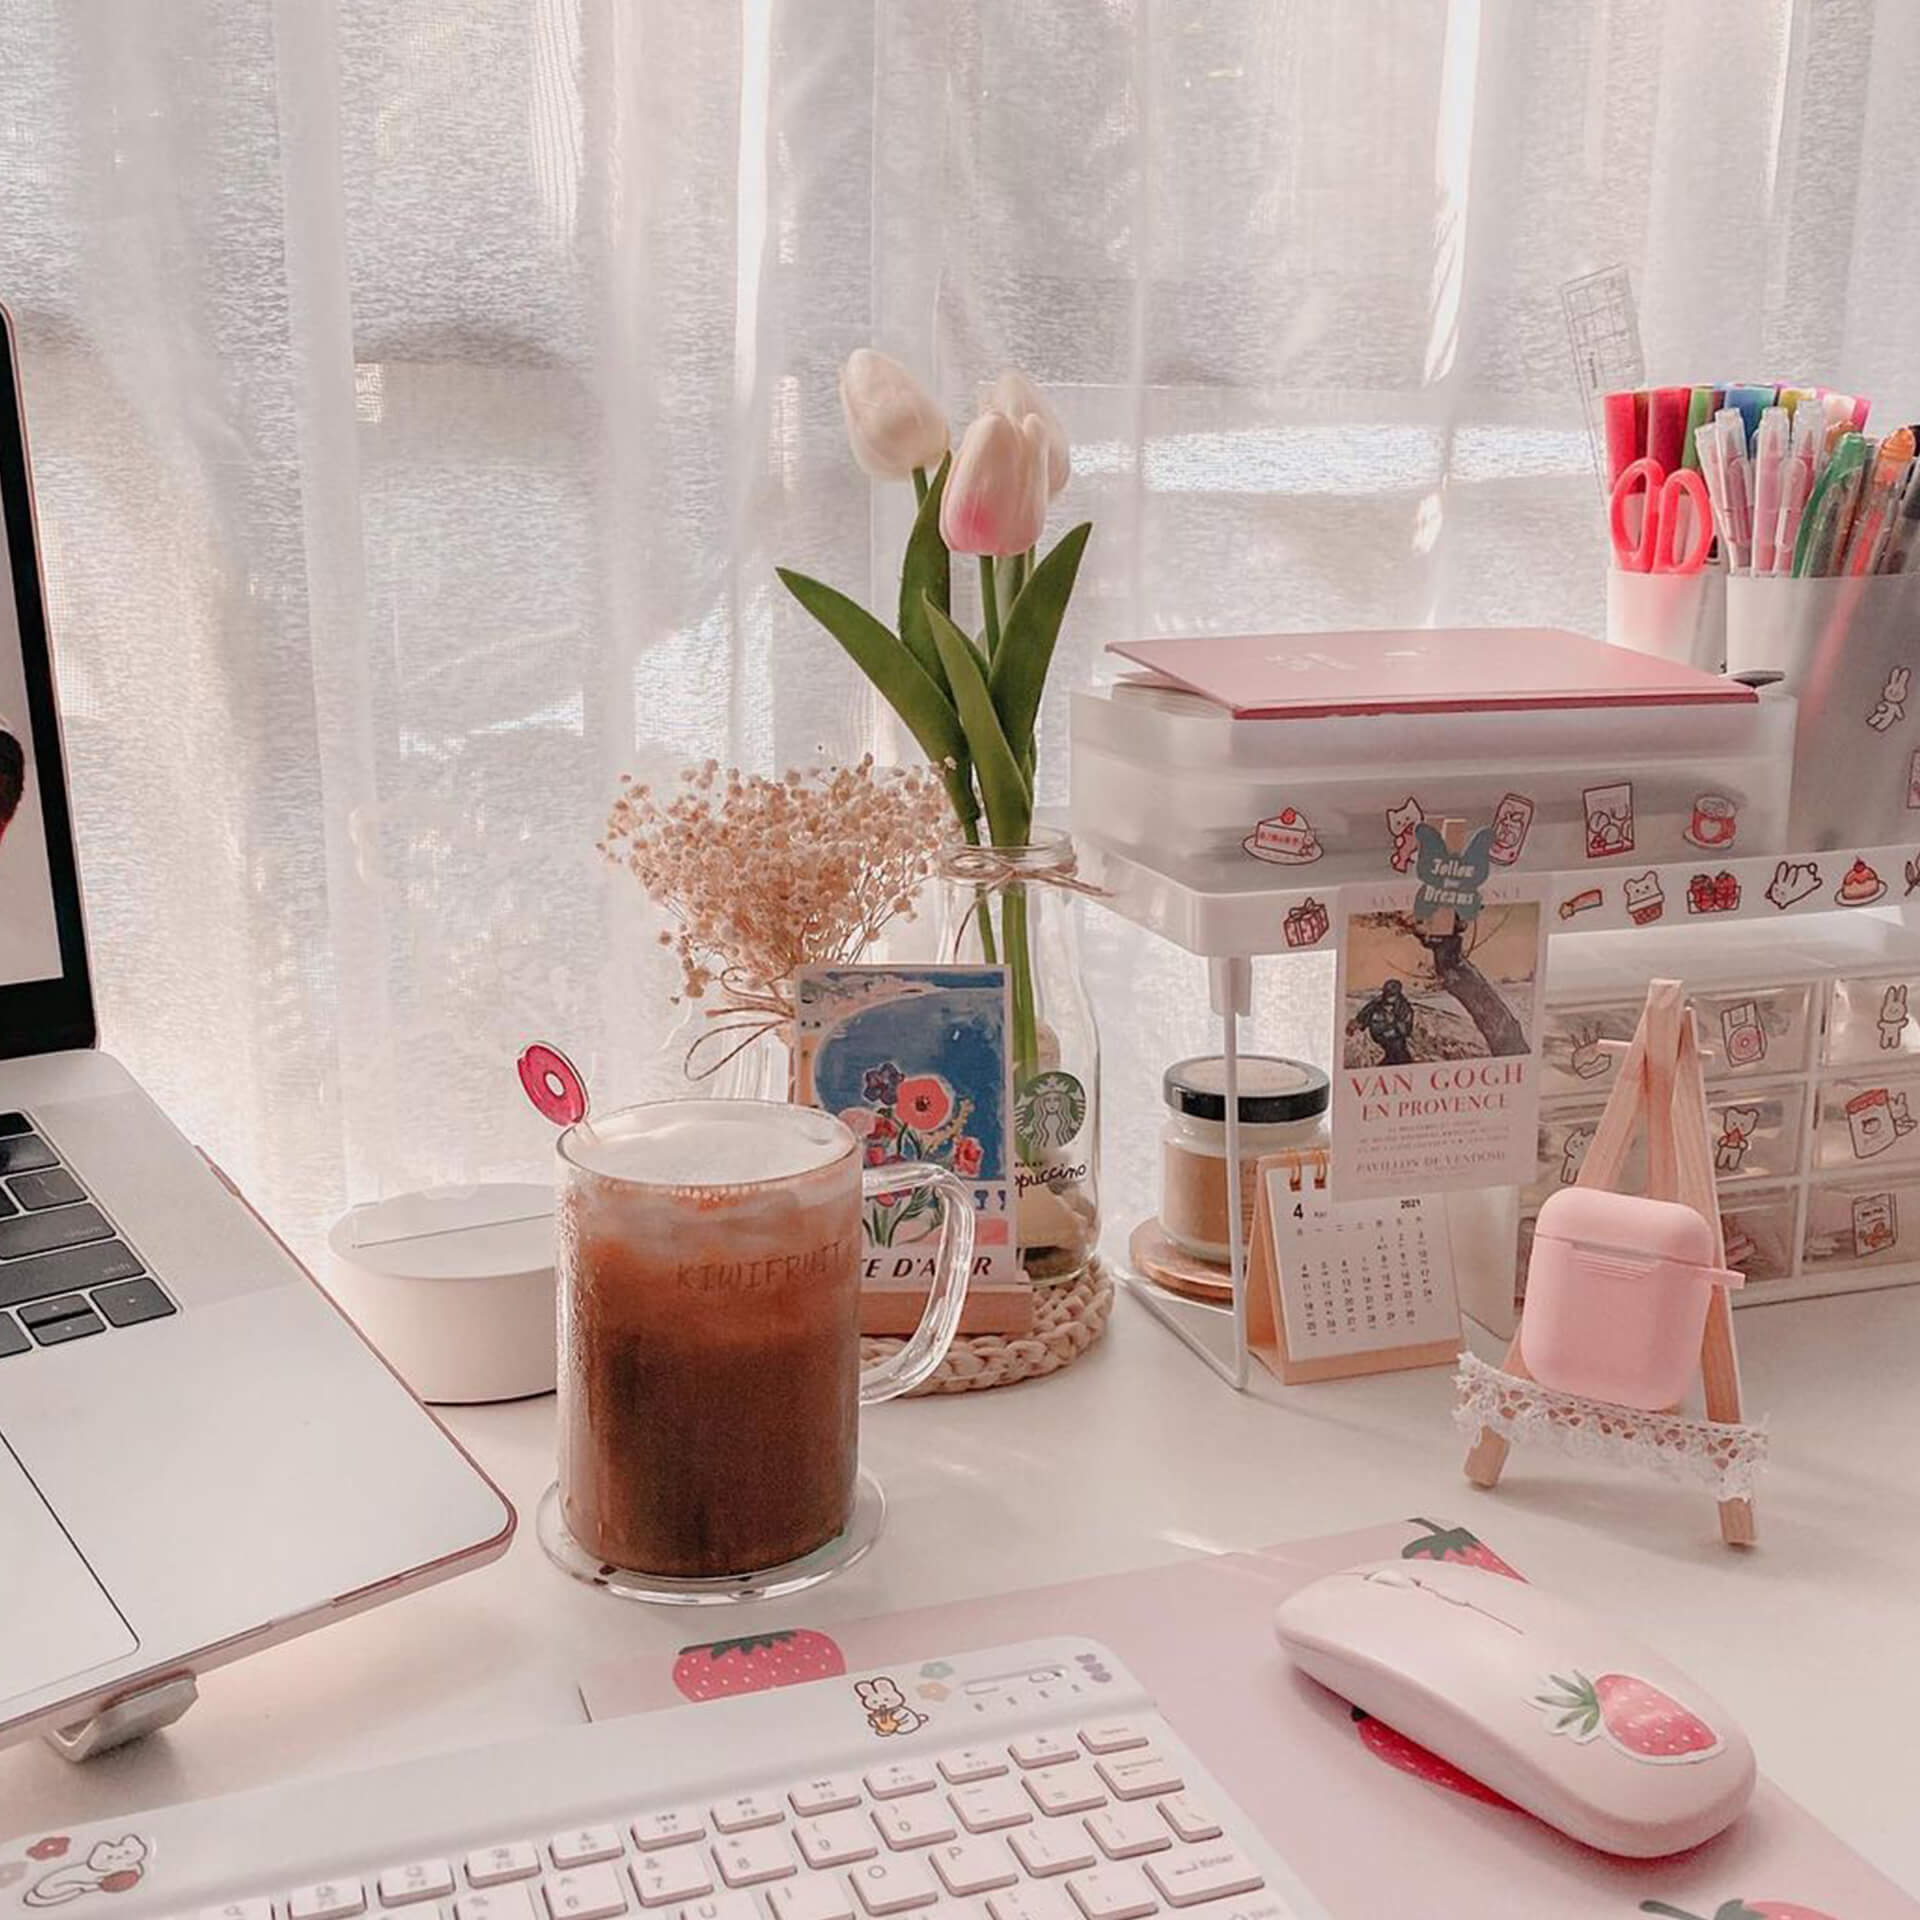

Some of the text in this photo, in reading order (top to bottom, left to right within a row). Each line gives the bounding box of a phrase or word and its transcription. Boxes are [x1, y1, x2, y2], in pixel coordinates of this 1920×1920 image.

[1351, 1063, 1523, 1098] VAN GOGH
[1399, 1092, 1509, 1118] PROVENCE
[1292, 1203, 1304, 1220] 4
[1400, 1198, 1421, 1210] 2021
